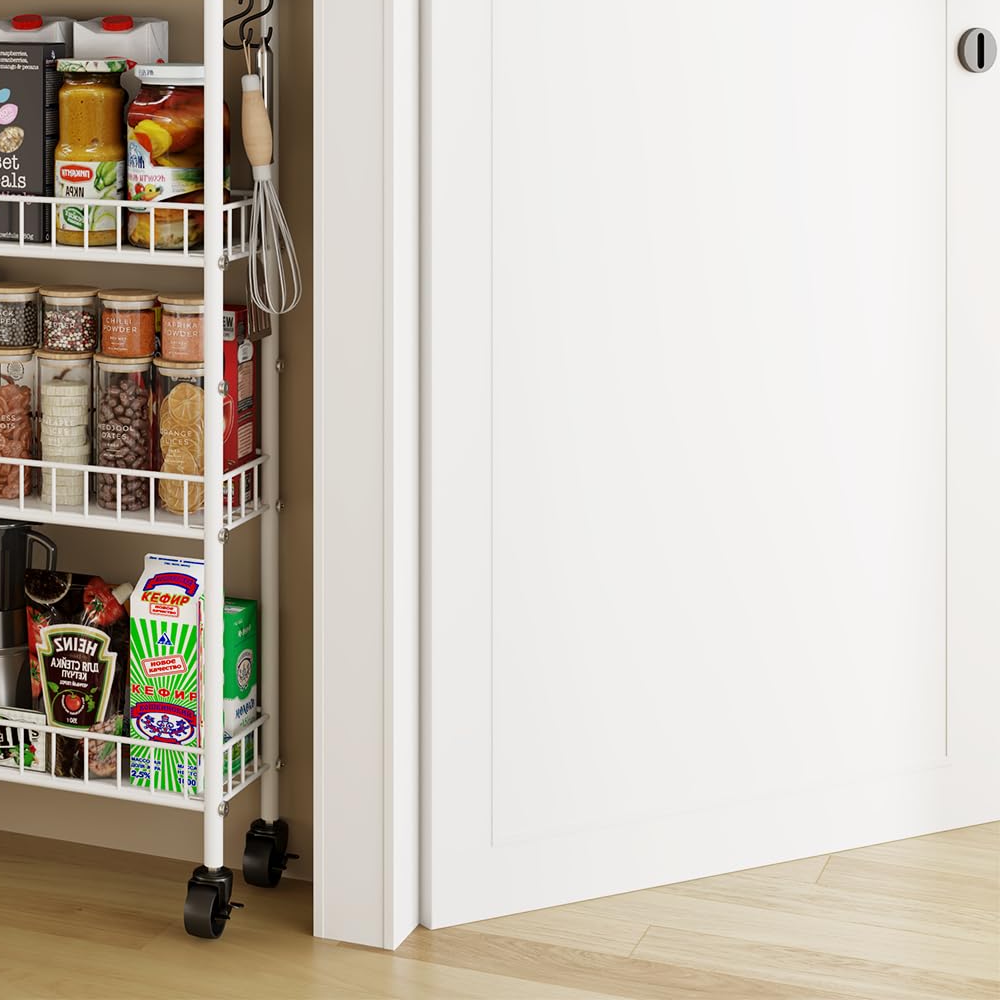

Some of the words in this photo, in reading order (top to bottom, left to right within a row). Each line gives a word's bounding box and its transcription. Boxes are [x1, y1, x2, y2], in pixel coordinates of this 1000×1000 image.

[105, 317, 132, 325] CHILLI
[167, 321, 198, 329] APRIKA
[222, 315, 233, 328] EW
[103, 325, 137, 333] POWDER
[167, 330, 200, 338] OWDER
[101, 432, 128, 440] DATES
[141, 591, 190, 606] КЕФИР
[132, 684, 197, 701] КЕФИР
[130, 756, 161, 765] МАССОАЯ
